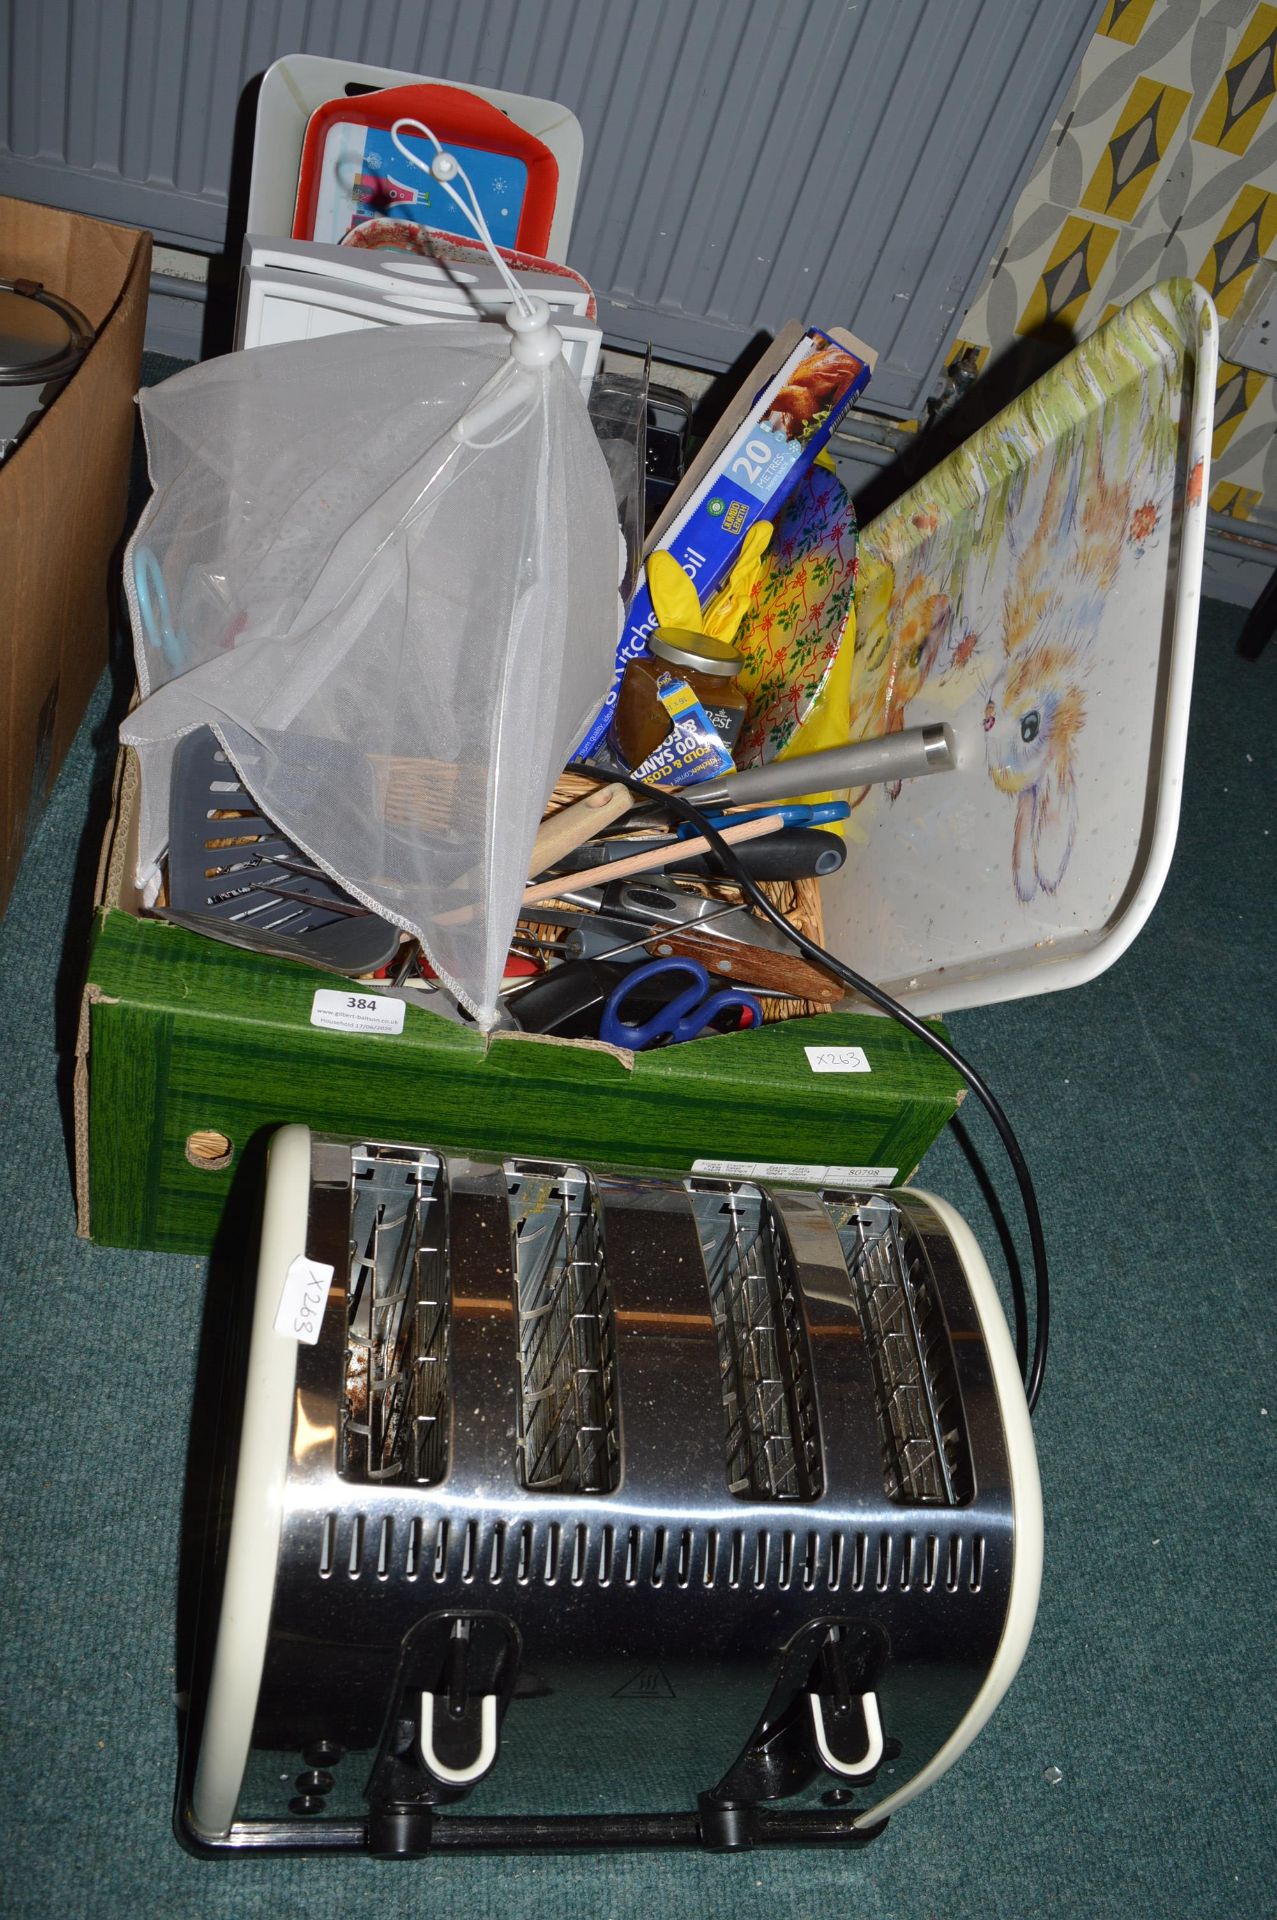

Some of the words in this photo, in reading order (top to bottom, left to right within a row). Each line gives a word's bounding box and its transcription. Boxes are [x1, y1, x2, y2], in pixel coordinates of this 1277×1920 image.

[732, 440, 772, 484] 20
[757, 455, 785, 489] METRES
[724, 502, 740, 530] JUMBO
[732, 505, 748, 534] LENGTH
[615, 611, 660, 682] itche
[683, 547, 707, 580] oil
[672, 759, 683, 769] &
[683, 745, 712, 764] FOLD
[641, 765, 672, 785] CLOSE
[346, 997, 377, 1012] 384
[320, 1018, 354, 1028] Household
